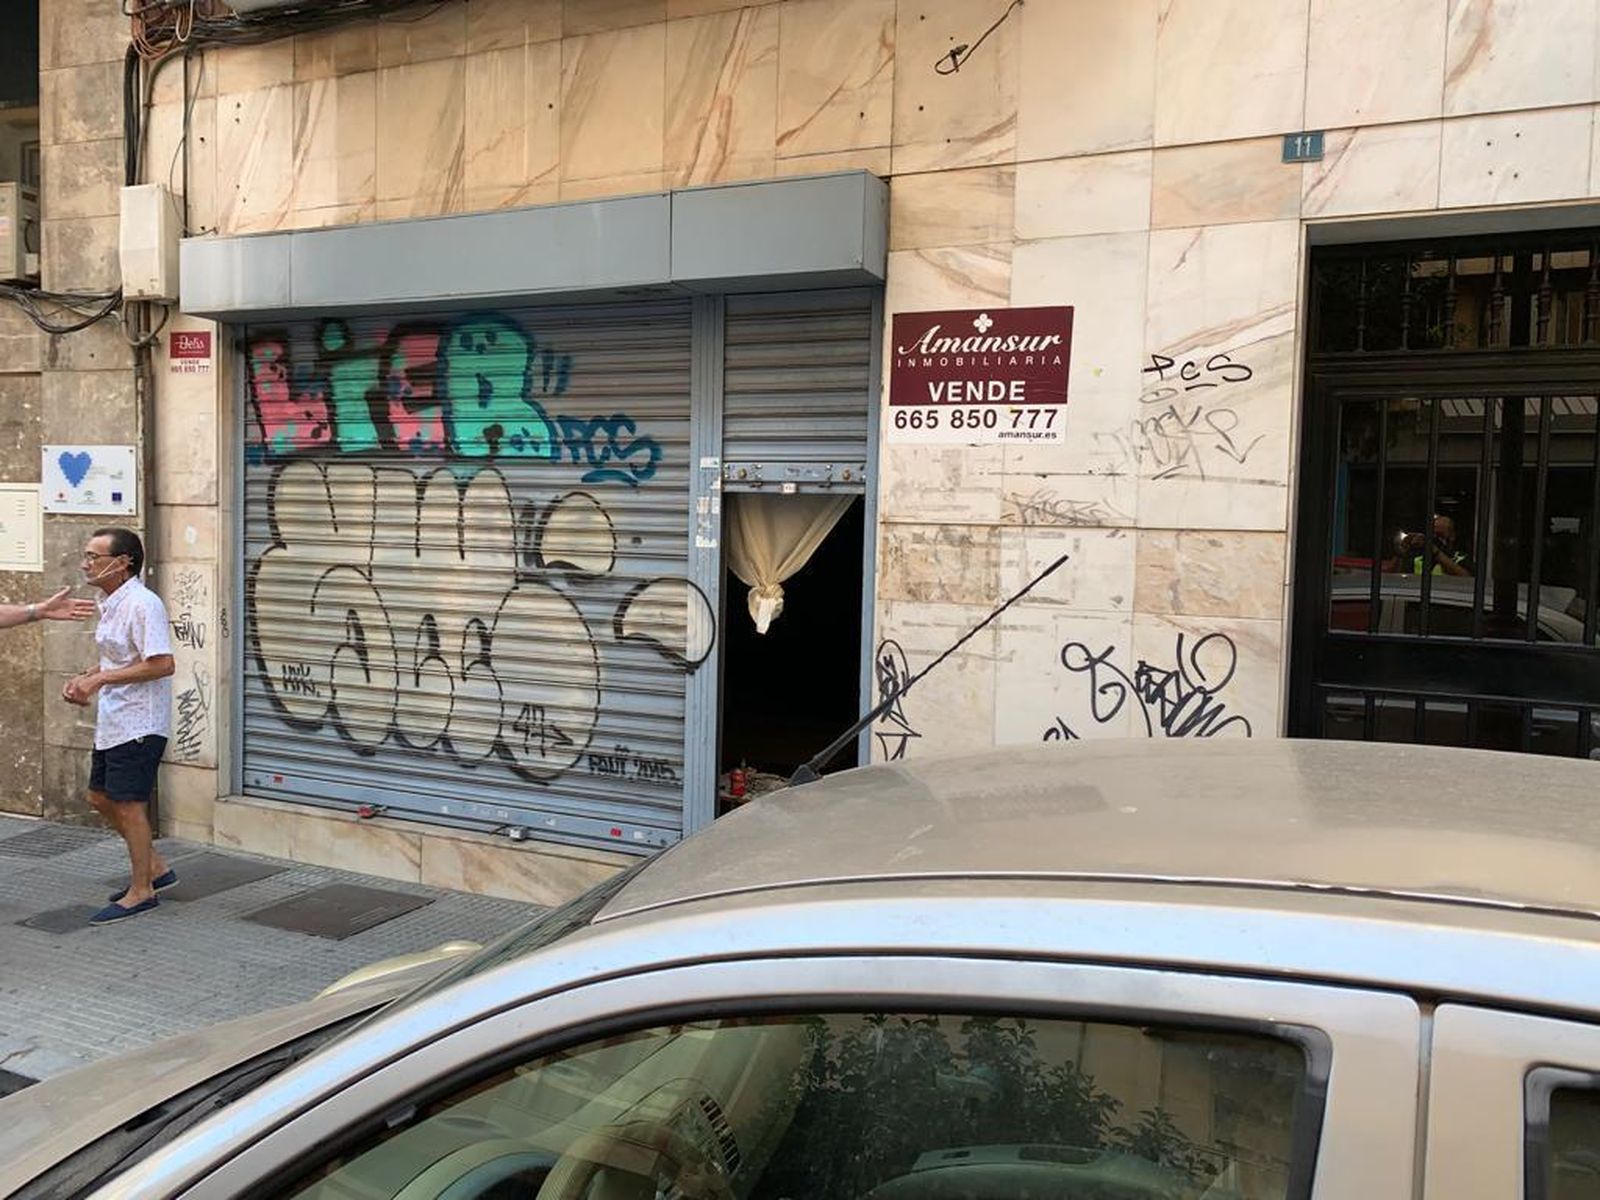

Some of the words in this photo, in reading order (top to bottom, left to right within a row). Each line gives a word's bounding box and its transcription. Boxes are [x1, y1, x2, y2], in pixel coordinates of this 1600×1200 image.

[1294, 136, 1311, 157] 11
[898, 325, 1063, 355] Amansur
[897, 355, 1062, 368] INMOBILIARIA
[928, 380, 1026, 403] VENDE
[894, 410, 939, 430] 665
[950, 409, 998, 429] 850
[1009, 408, 1059, 429] 777
[997, 430, 1058, 440] amansur.es
